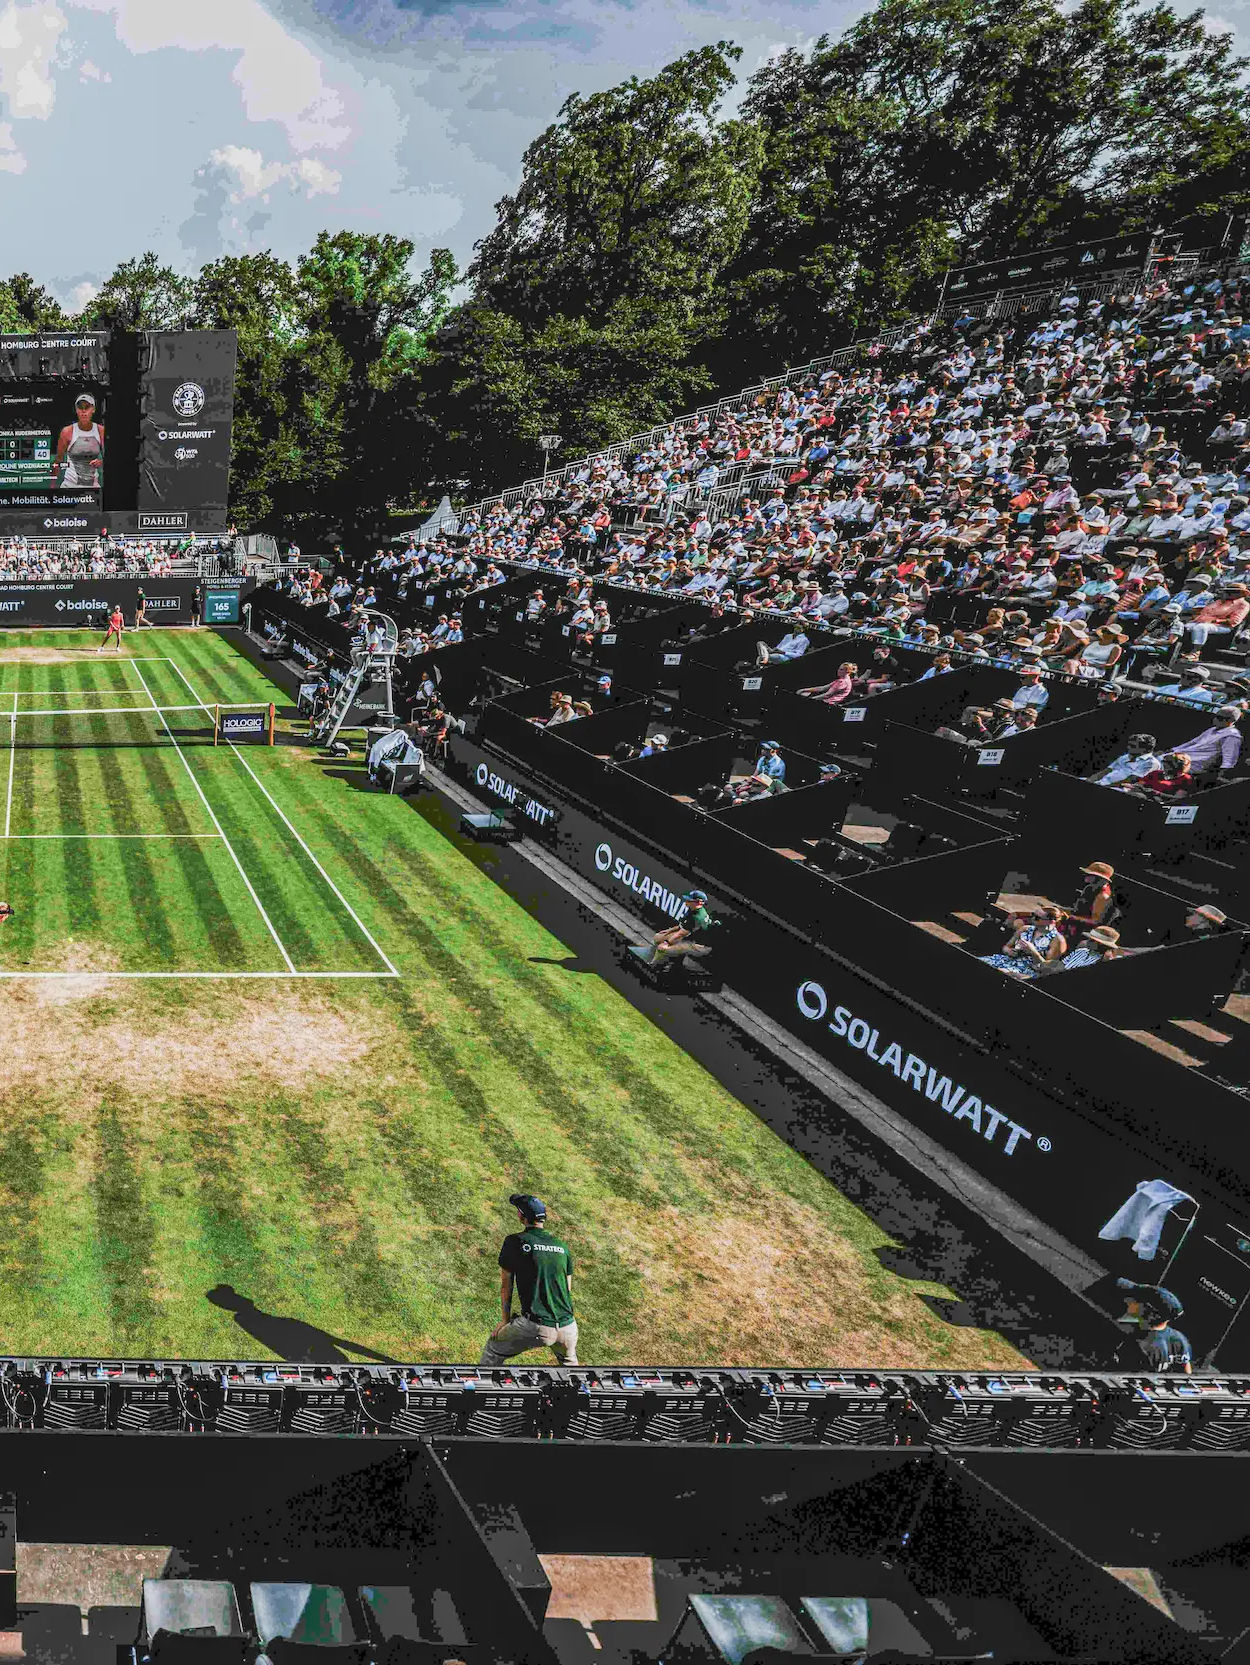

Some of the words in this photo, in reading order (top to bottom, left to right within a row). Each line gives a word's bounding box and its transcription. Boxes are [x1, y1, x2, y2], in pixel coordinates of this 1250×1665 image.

[1, 341, 39, 349] HOMBURG
[41, 340, 69, 348] CENTRE
[71, 339, 97, 347] COURT
[168, 430, 213, 439] SOLARWATT
[37, 440, 47, 448] 30
[12, 496, 51, 505] Mobilität.
[53, 495, 95, 504] Solarwatt.
[54, 517, 88, 527] baloise
[142, 516, 184, 526] DAHLER
[66, 599, 108, 610] baloise
[214, 603, 230, 611] 165
[223, 718, 263, 728] HOLOGIC
[533, 1244, 565, 1254] STRATECO
[1200, 1276, 1237, 1304] newkee
